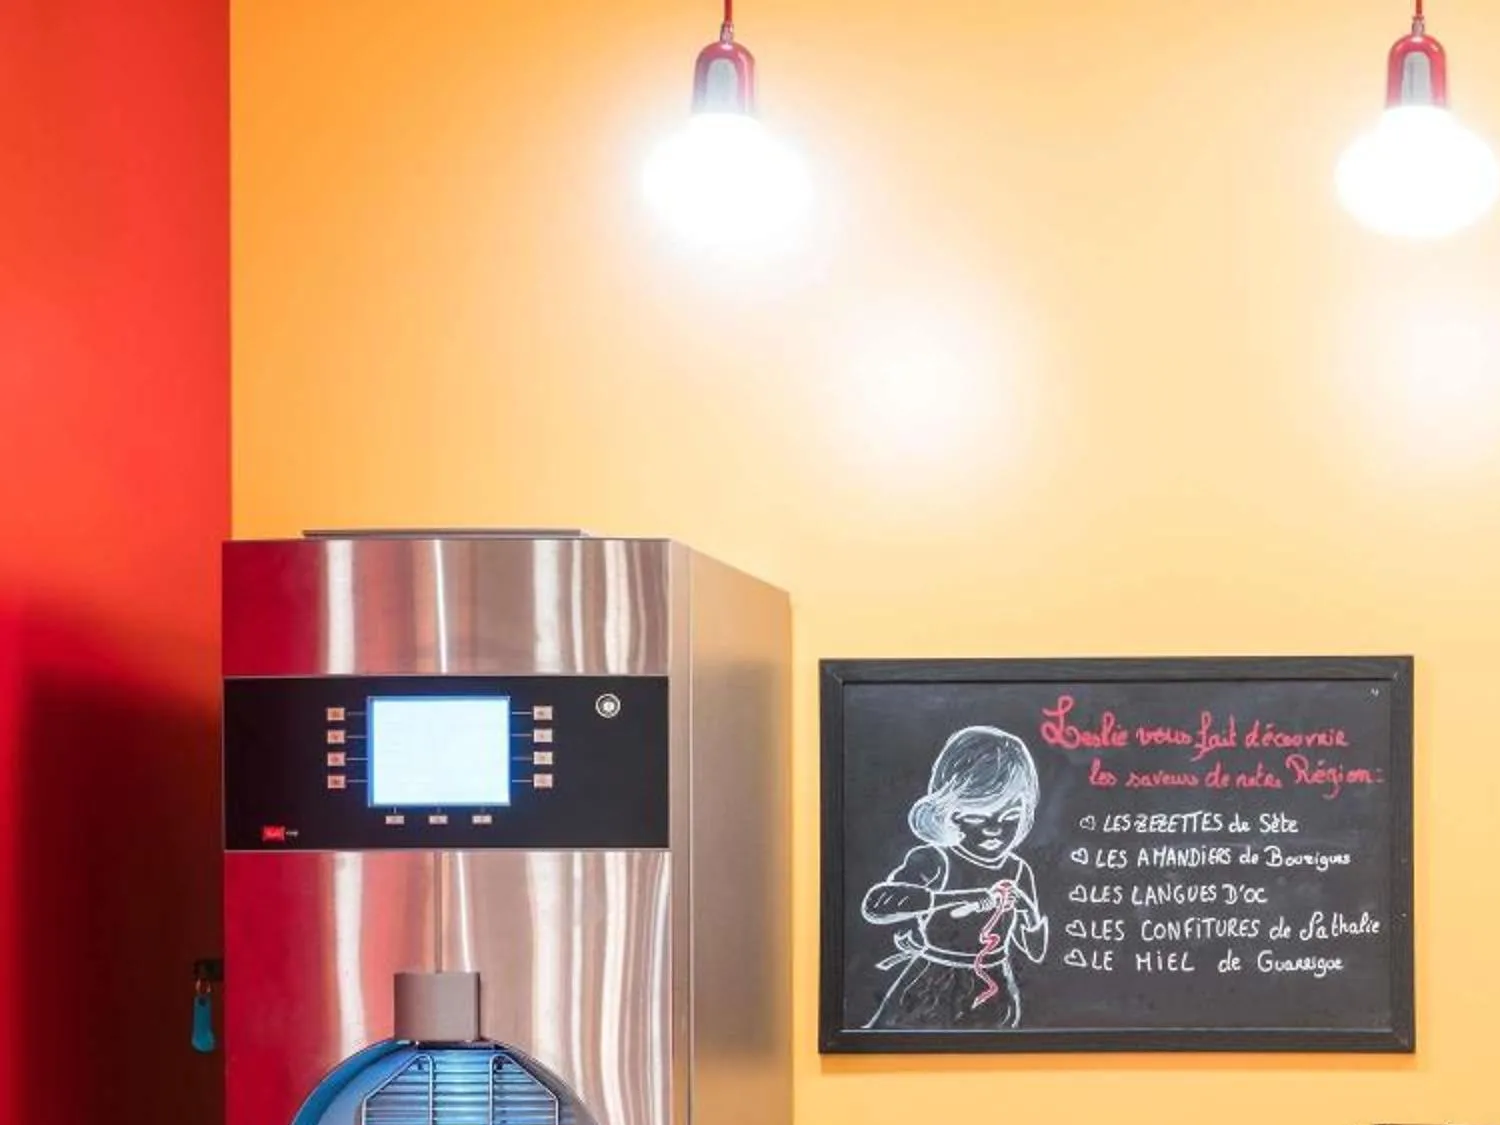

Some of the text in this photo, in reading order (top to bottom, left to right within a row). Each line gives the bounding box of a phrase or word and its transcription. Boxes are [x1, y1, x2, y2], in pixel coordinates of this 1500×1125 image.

[1041, 695, 1350, 763] Leslie vous fait découvrir
[1088, 757, 1119, 787] les
[1124, 770, 1200, 788] saveurs
[1204, 759, 1231, 788] de
[1235, 761, 1284, 789] notre
[1103, 813, 1132, 833] LES
[1228, 812, 1251, 834] de
[1258, 812, 1300, 834] Sète
[1095, 848, 1128, 869] LES
[1238, 845, 1260, 865] de
[1089, 882, 1269, 907] LES LANGUES D'OC
[1090, 918, 1126, 942] LES
[1268, 916, 1293, 941] de
[1090, 949, 1115, 971] LE
[1217, 948, 1242, 973] de
